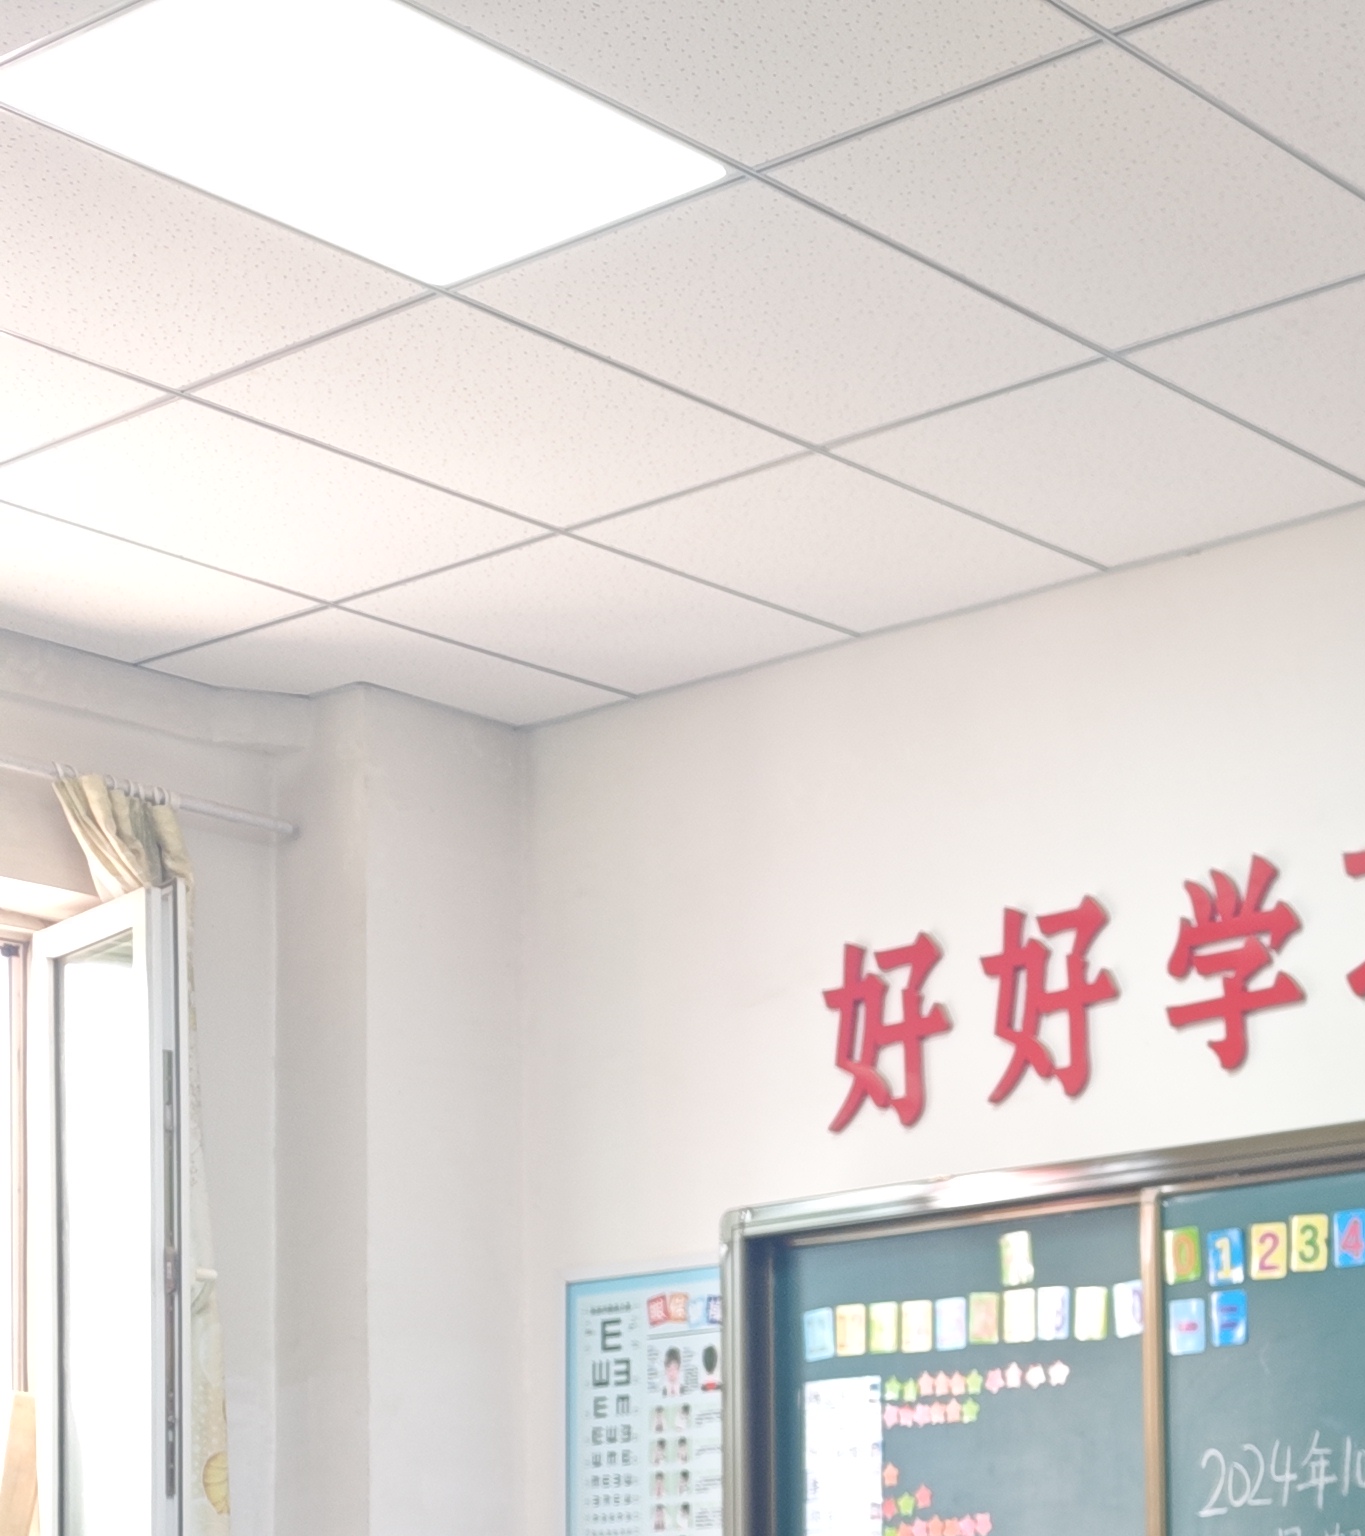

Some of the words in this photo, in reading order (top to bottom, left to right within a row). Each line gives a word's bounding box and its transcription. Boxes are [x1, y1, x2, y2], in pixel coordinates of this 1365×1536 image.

[1172, 1233, 1197, 1276] 0
[1215, 1237, 1233, 1280] 1
[1258, 1232, 1280, 1271] 2
[1299, 1224, 1320, 1263] 3
[1341, 1215, 1365, 1260] 4
